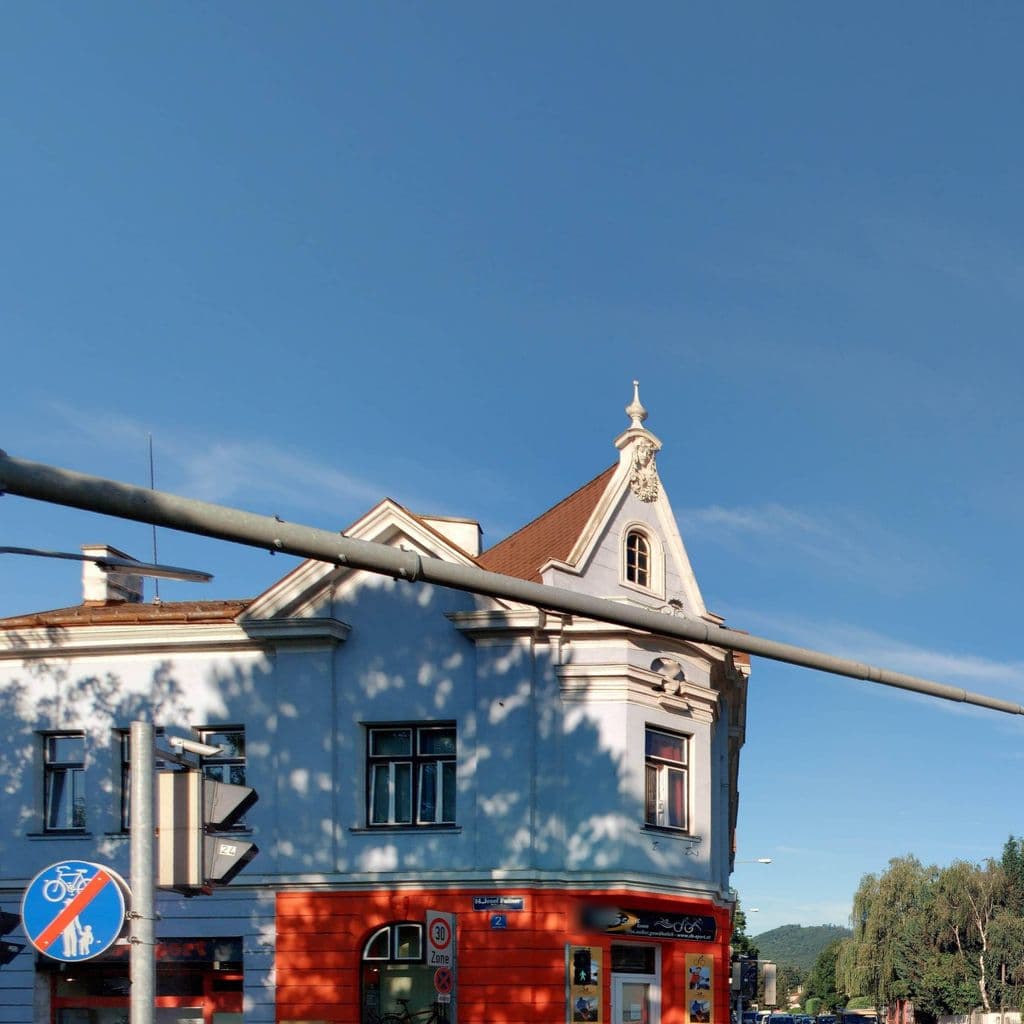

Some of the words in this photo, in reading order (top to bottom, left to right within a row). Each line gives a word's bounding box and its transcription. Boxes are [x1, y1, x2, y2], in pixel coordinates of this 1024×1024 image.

[495, 916, 503, 926] 2
[435, 926, 446, 941] 30
[431, 951, 449, 964] Zone
